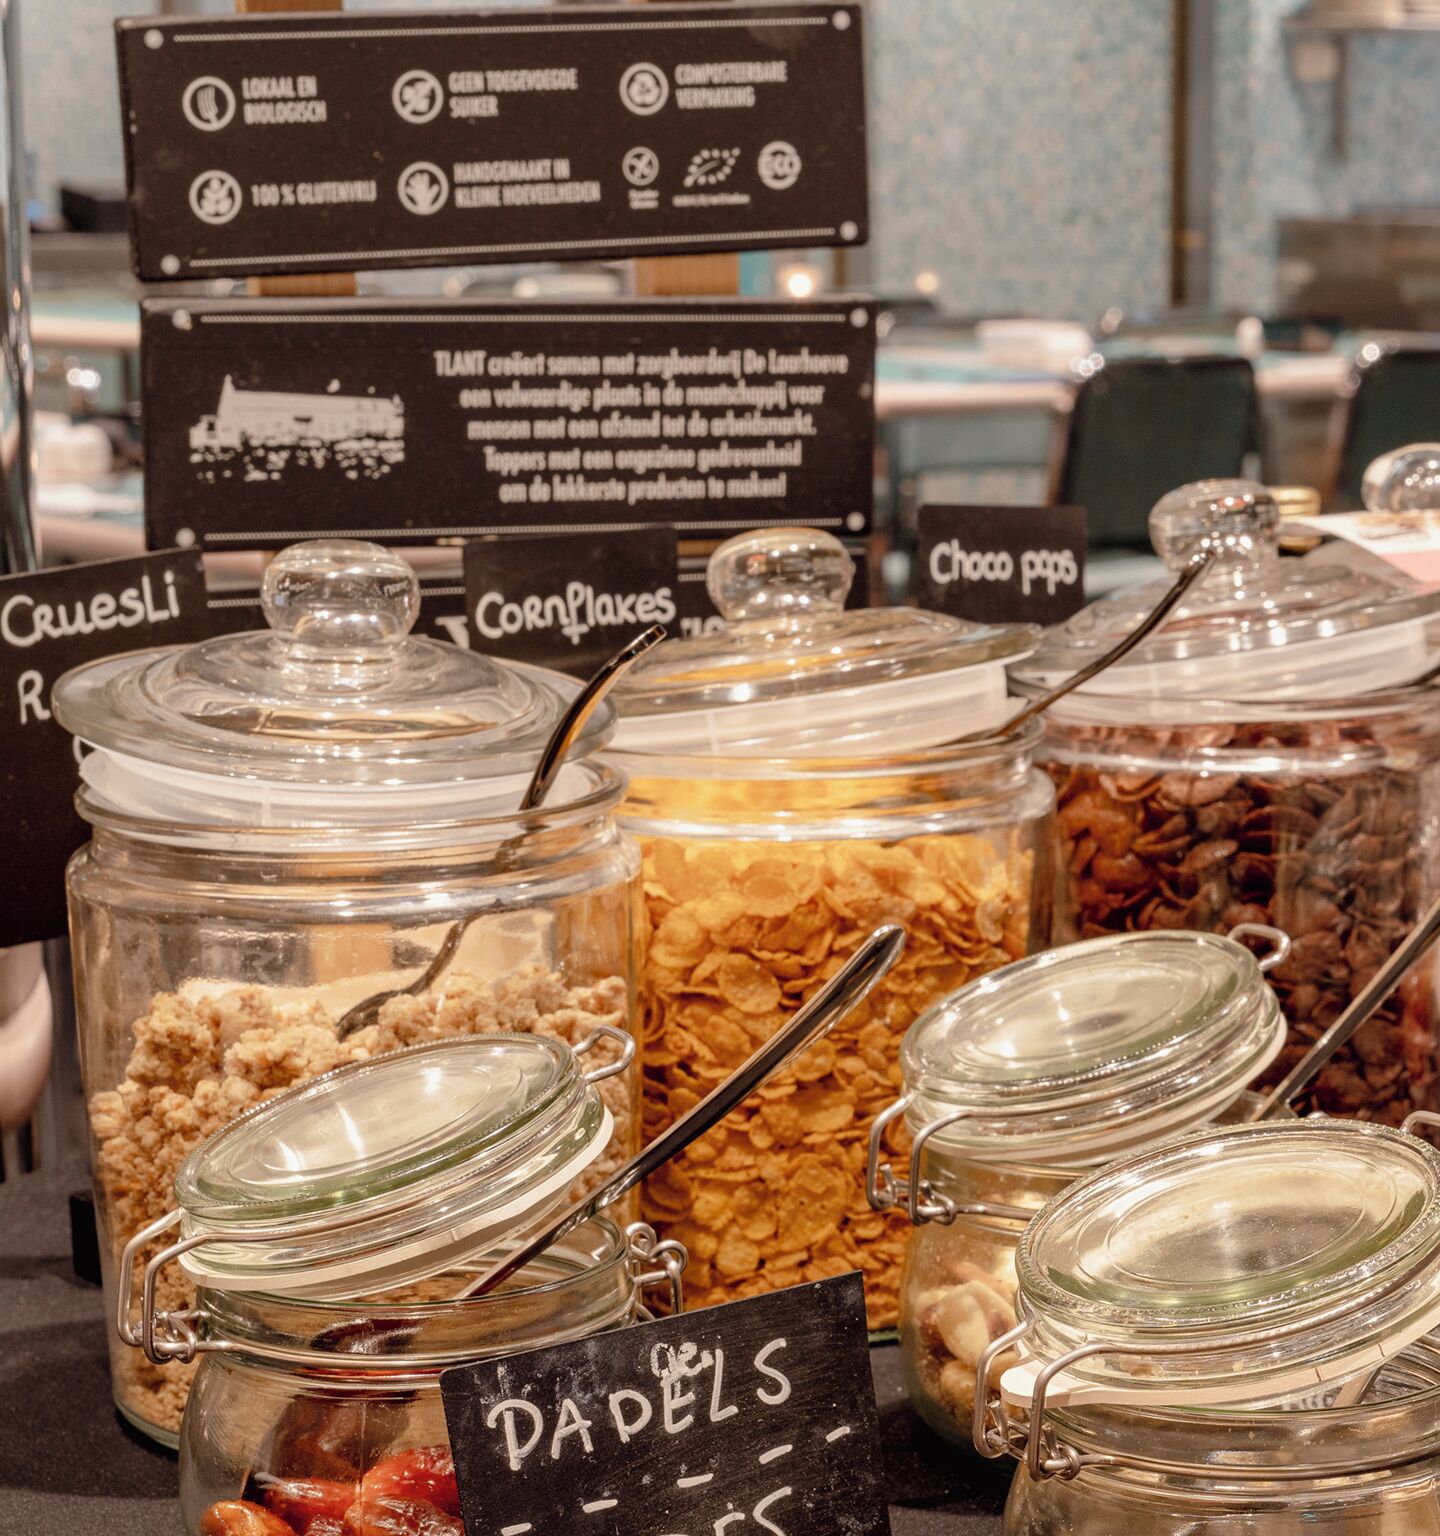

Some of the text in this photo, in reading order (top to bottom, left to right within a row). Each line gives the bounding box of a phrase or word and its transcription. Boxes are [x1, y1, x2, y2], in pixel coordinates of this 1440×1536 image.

[242, 76, 296, 99] LOKAAL
[244, 100, 327, 123] BIOLOGISCH
[251, 185, 279, 206] 100
[280, 184, 296, 206] %
[547, 356, 600, 376] samen
[602, 352, 634, 375] met
[743, 349, 766, 374] De
[459, 389, 492, 408] een
[592, 379, 642, 412] plaats
[643, 382, 661, 406] in
[662, 379, 684, 406] de
[788, 385, 826, 405] voor
[467, 420, 531, 440] mensen
[532, 416, 566, 439] met
[567, 418, 599, 439] een
[600, 410, 660, 438] afstand
[662, 415, 686, 437] tot
[686, 409, 709, 437] de
[483, 446, 546, 476] Toppers
[547, 447, 581, 470] met
[582, 451, 614, 470] een
[615, 444, 696, 474] ongeziene
[499, 483, 527, 503] om
[528, 475, 550, 502] de
[627, 472, 706, 505] producten
[707, 476, 726, 498] te
[930, 539, 1078, 596] Choco pops
